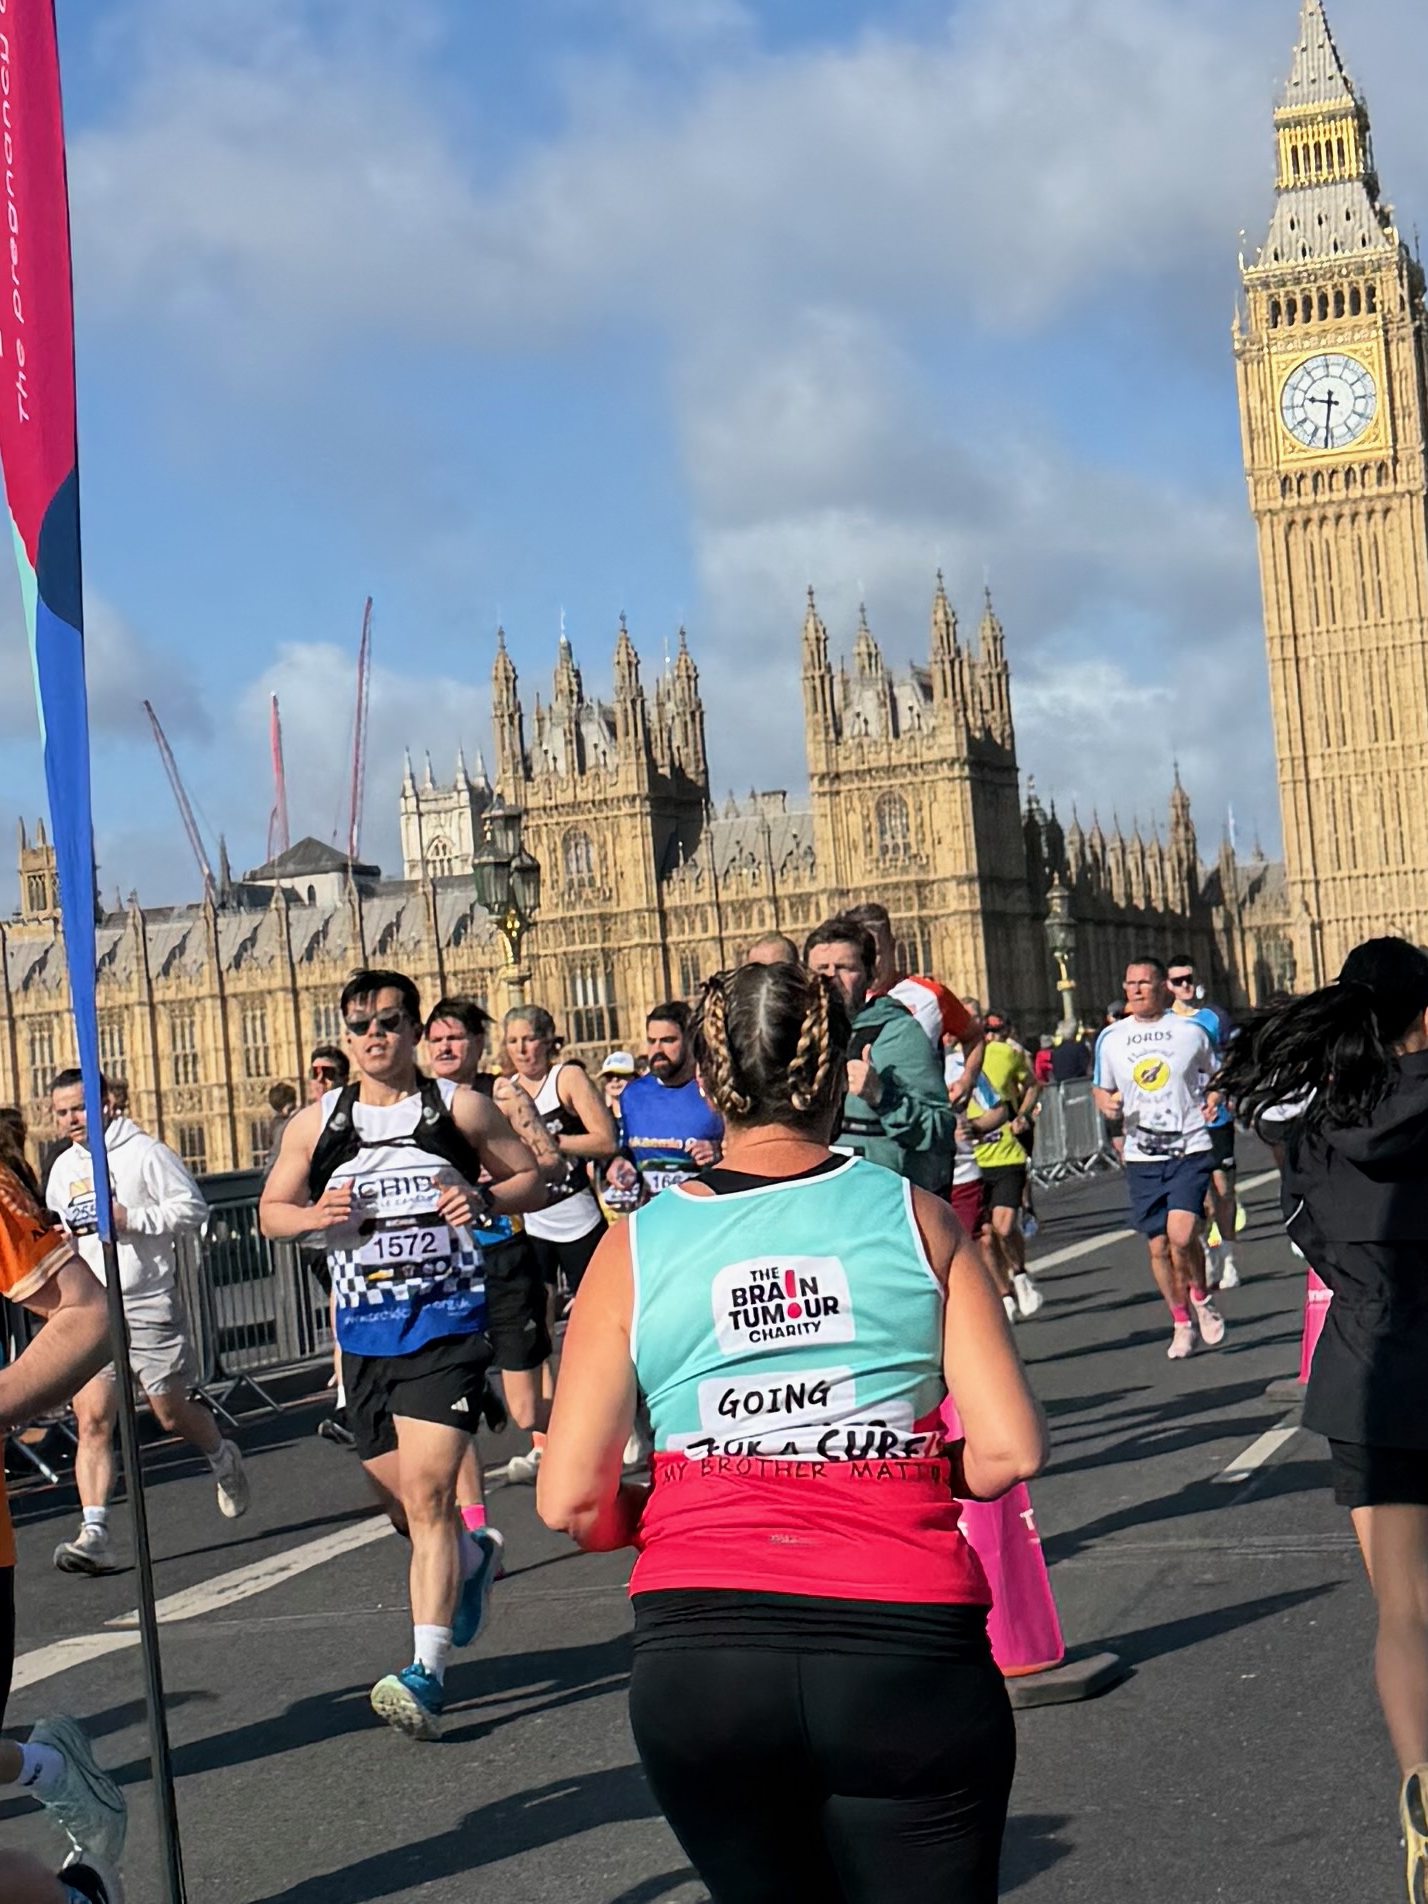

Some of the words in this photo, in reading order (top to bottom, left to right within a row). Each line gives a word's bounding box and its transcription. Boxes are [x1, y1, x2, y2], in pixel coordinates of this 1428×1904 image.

[14, 339, 30, 424] The
[358, 1175, 434, 1200] CHID
[374, 1232, 437, 1259] 1572
[750, 1267, 779, 1283] THE
[728, 1296, 840, 1331] TUMOUR
[749, 1321, 821, 1343] CHARITY
[717, 1380, 832, 1419] GOING
[701, 1456, 828, 1480] BROTHER
